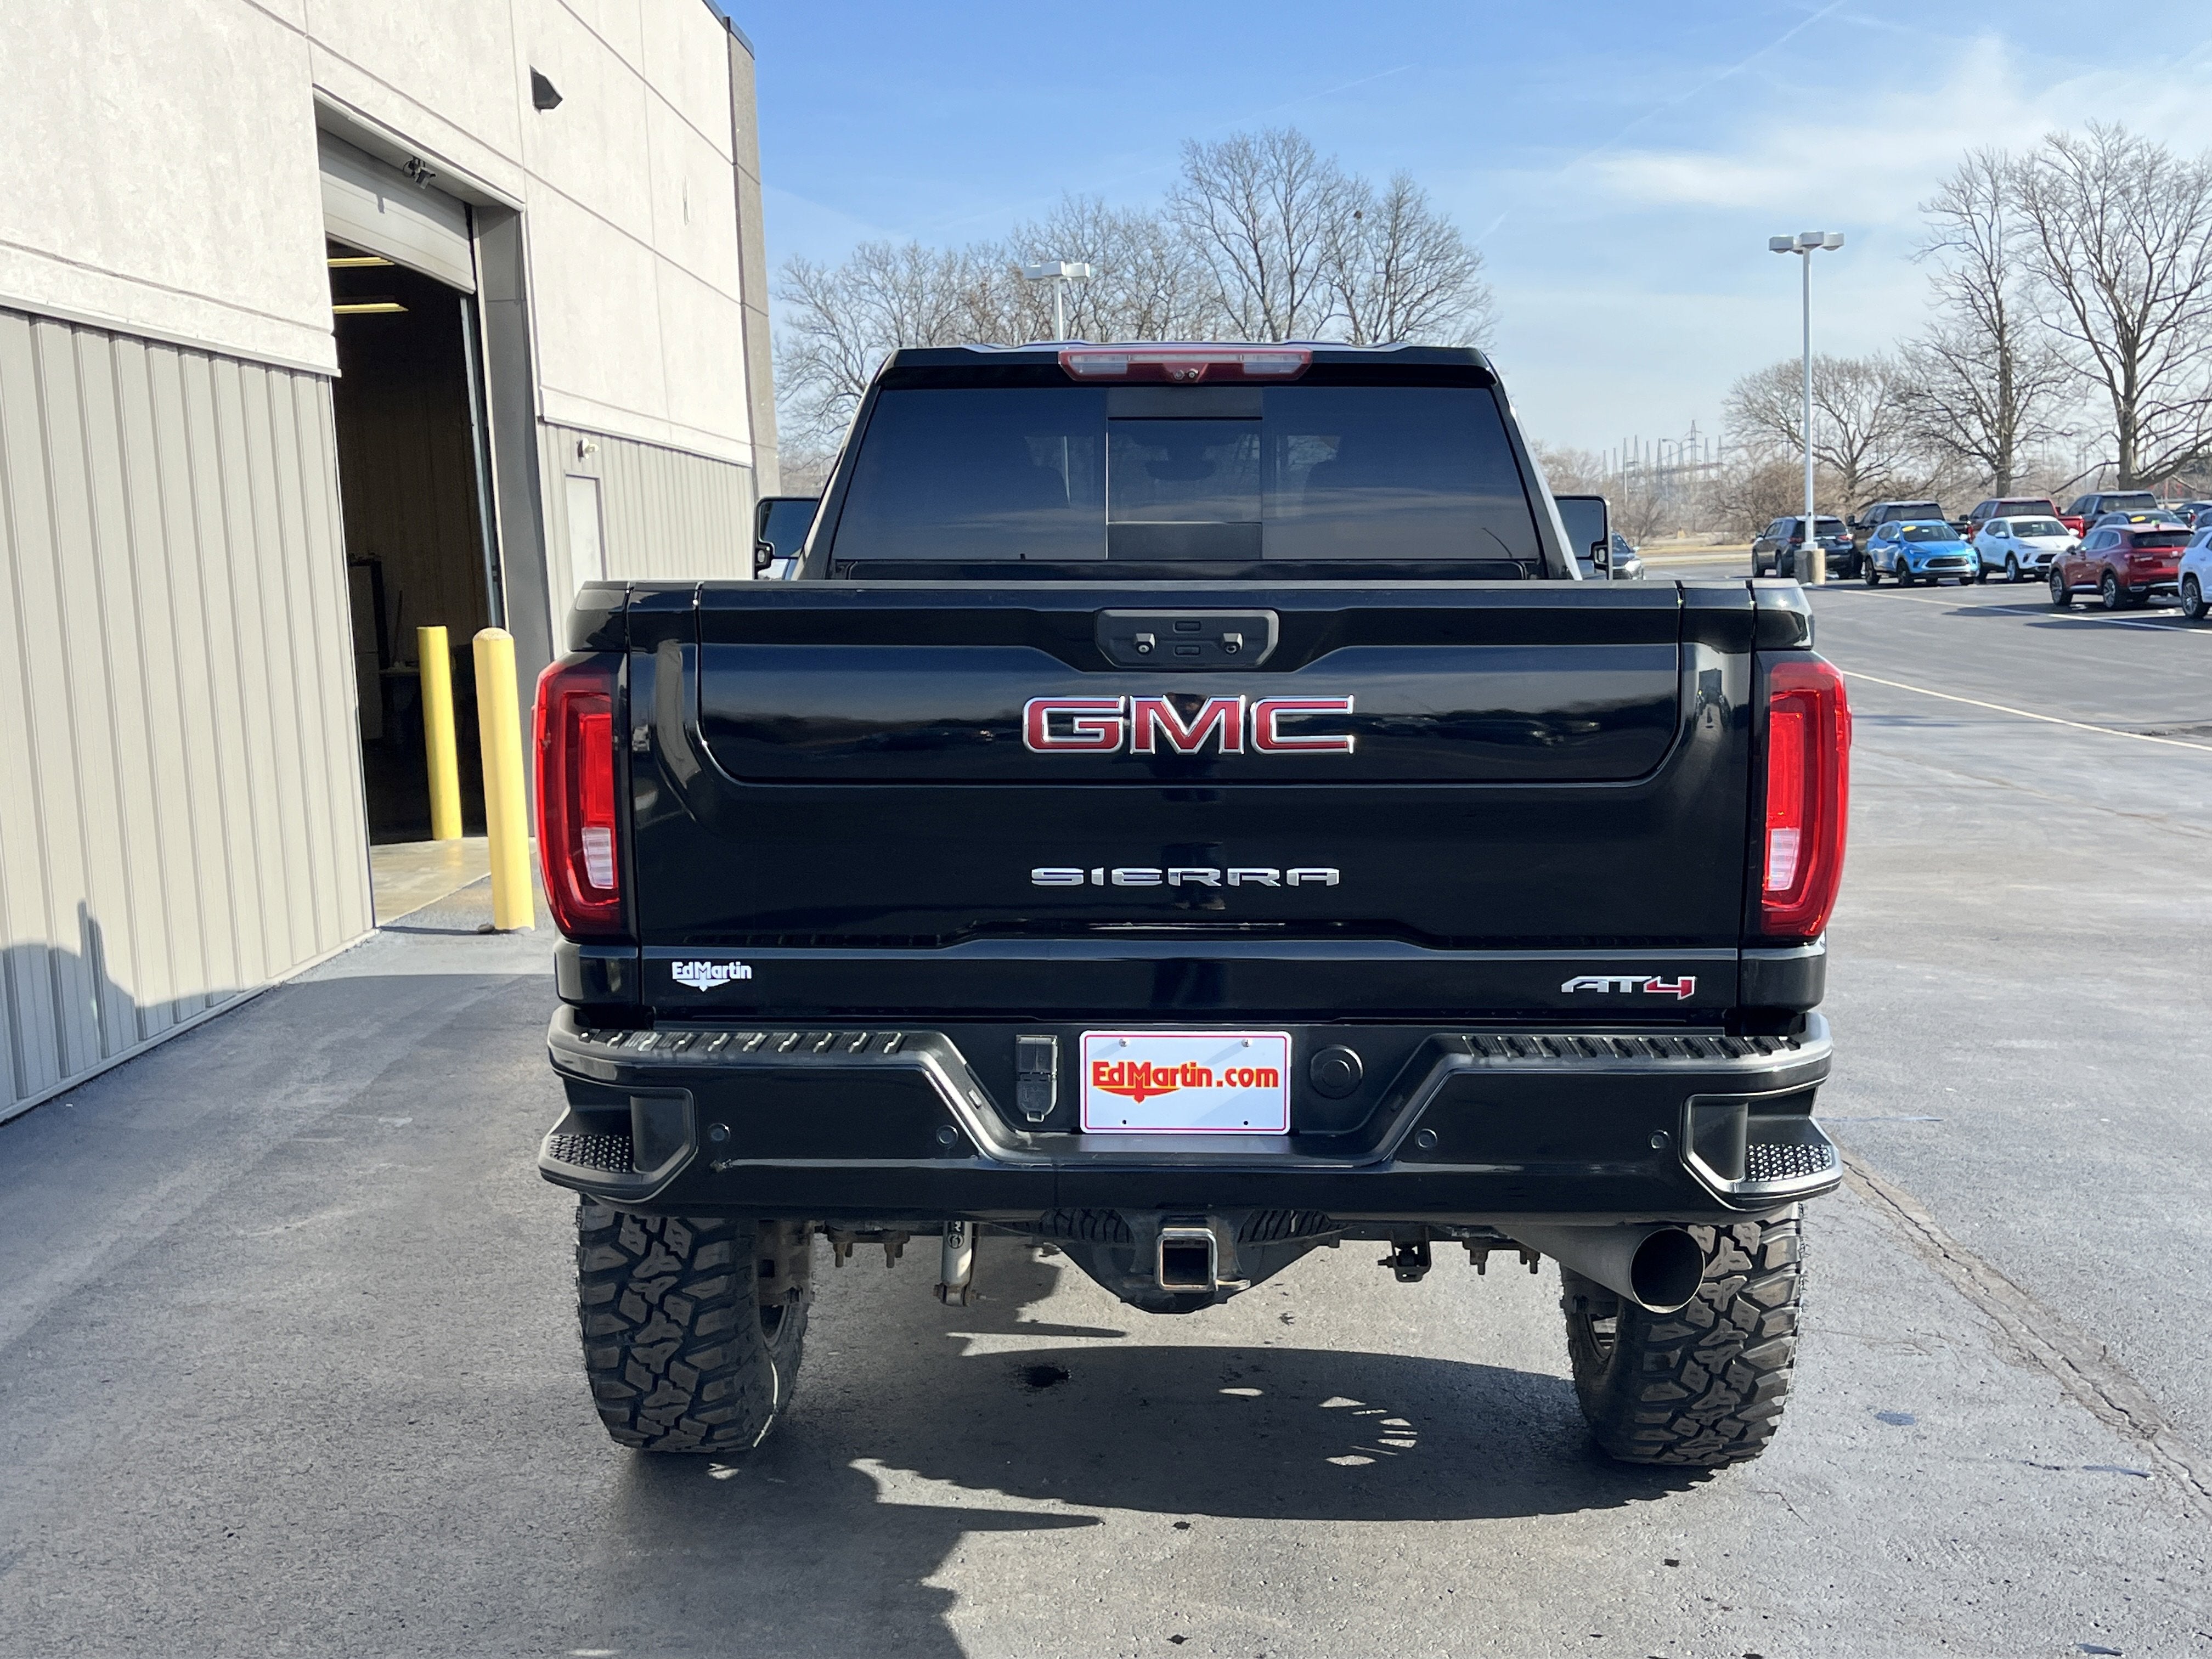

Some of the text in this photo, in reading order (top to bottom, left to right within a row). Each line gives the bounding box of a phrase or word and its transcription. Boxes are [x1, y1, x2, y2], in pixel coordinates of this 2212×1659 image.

[1022, 695, 1355, 755] GMC
[1031, 867, 1340, 887] SIERRA
[1561, 975, 1696, 1000] AT4
[1092, 1061, 1279, 1089] EdMartin.com
